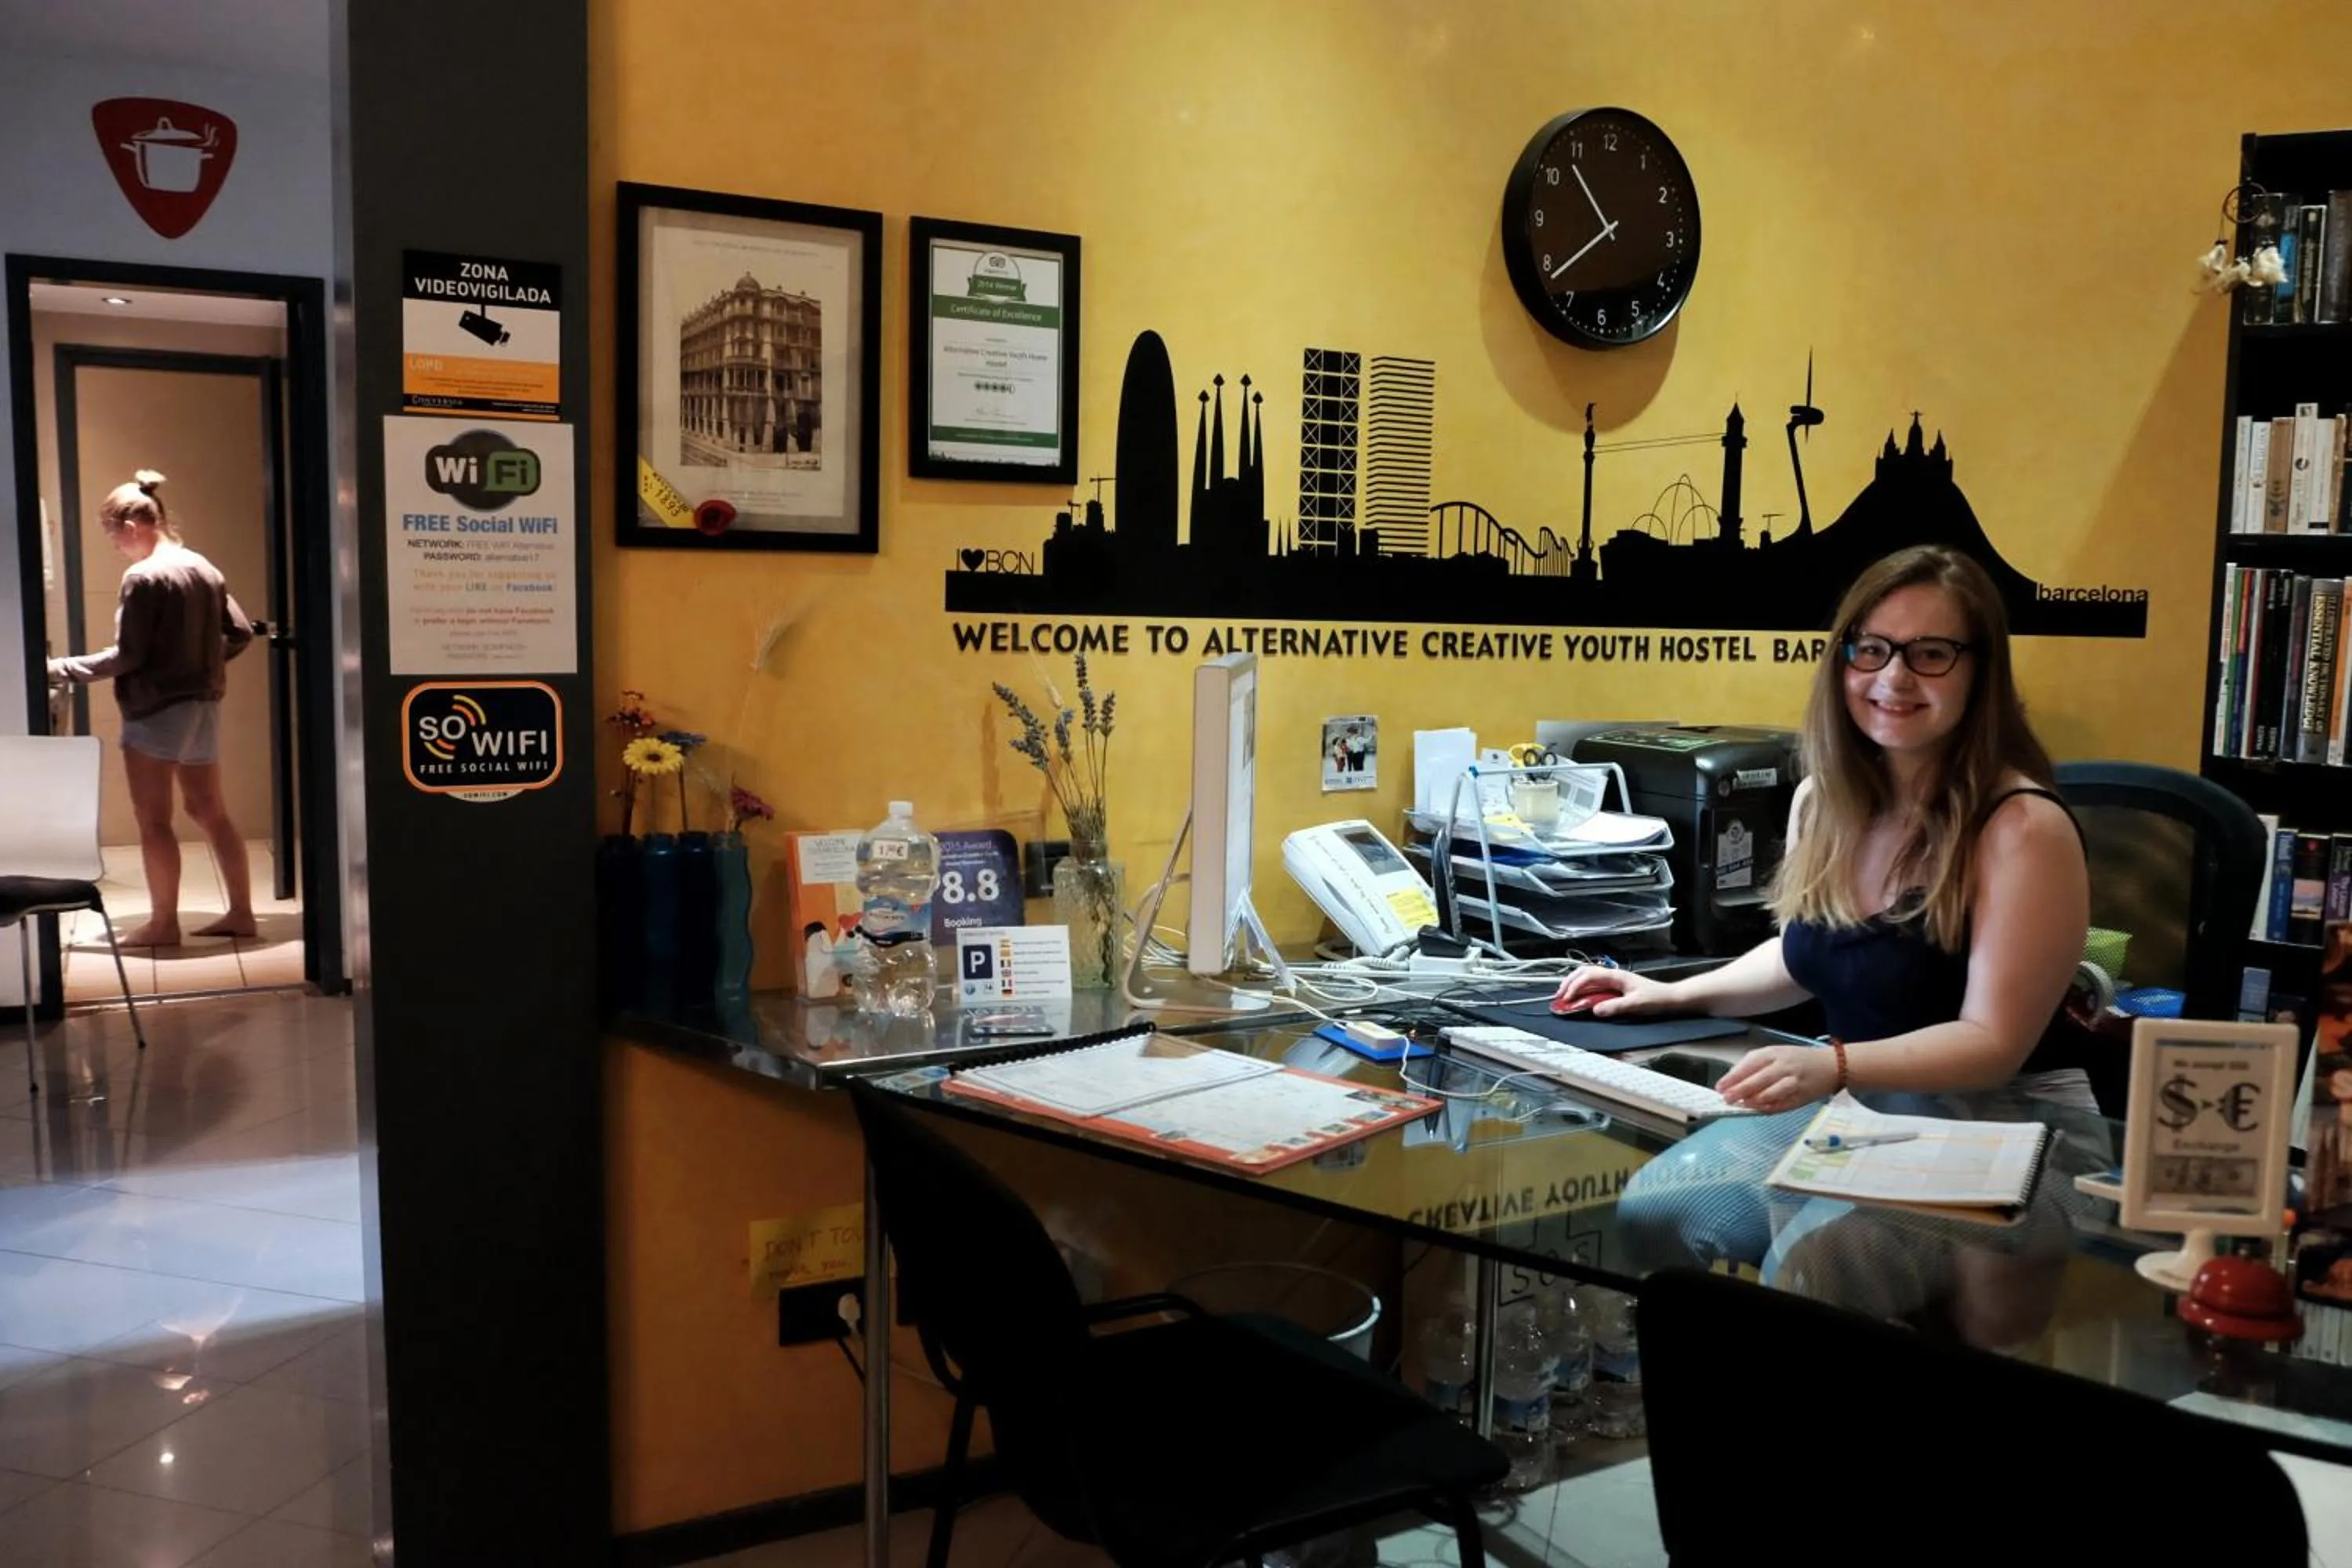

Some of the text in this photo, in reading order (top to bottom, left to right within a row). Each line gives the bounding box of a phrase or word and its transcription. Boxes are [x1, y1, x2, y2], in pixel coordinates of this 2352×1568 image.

[1570, 142, 1583, 158] 11
[1604, 134, 1617, 151] 12
[1640, 154, 1646, 170] 1
[1546, 168, 1559, 185] 10
[1658, 187, 1668, 204] 2
[1534, 209, 1544, 227] 9
[1666, 231, 1674, 248] 3
[1542, 254, 1552, 271] 8
[459, 262, 509, 281] ZONA
[1657, 272, 1664, 288] 4
[414, 277, 551, 304] VIDEOVIGILADA
[1566, 291, 1575, 307] 7
[950, 303, 1042, 321] Certificate of Excellence
[1632, 300, 1639, 317] 5
[1597, 309, 1606, 326] 6
[402, 514, 451, 532] FREE
[457, 516, 514, 534] Social
[956, 547, 1035, 575] I BCN
[2039, 583, 2149, 602] barcelona
[953, 622, 1129, 653] WELCOME
[1146, 625, 1189, 653] TO
[1202, 626, 1409, 658] ALTERNATIVE
[1421, 630, 1553, 659] CREATIVE
[1564, 634, 1650, 662] YOUTH
[1660, 636, 1756, 662] HOSTEL
[419, 715, 467, 741] SO
[471, 730, 548, 757] WIFI
[419, 760, 548, 774] FREE SOCIAL WIFI
[942, 868, 1000, 904] 8.8
[943, 916, 982, 927] Booking
[970, 950, 985, 973] P
[2157, 1073, 2262, 1134] $ €
[2172, 1138, 2241, 1153] Exchange
